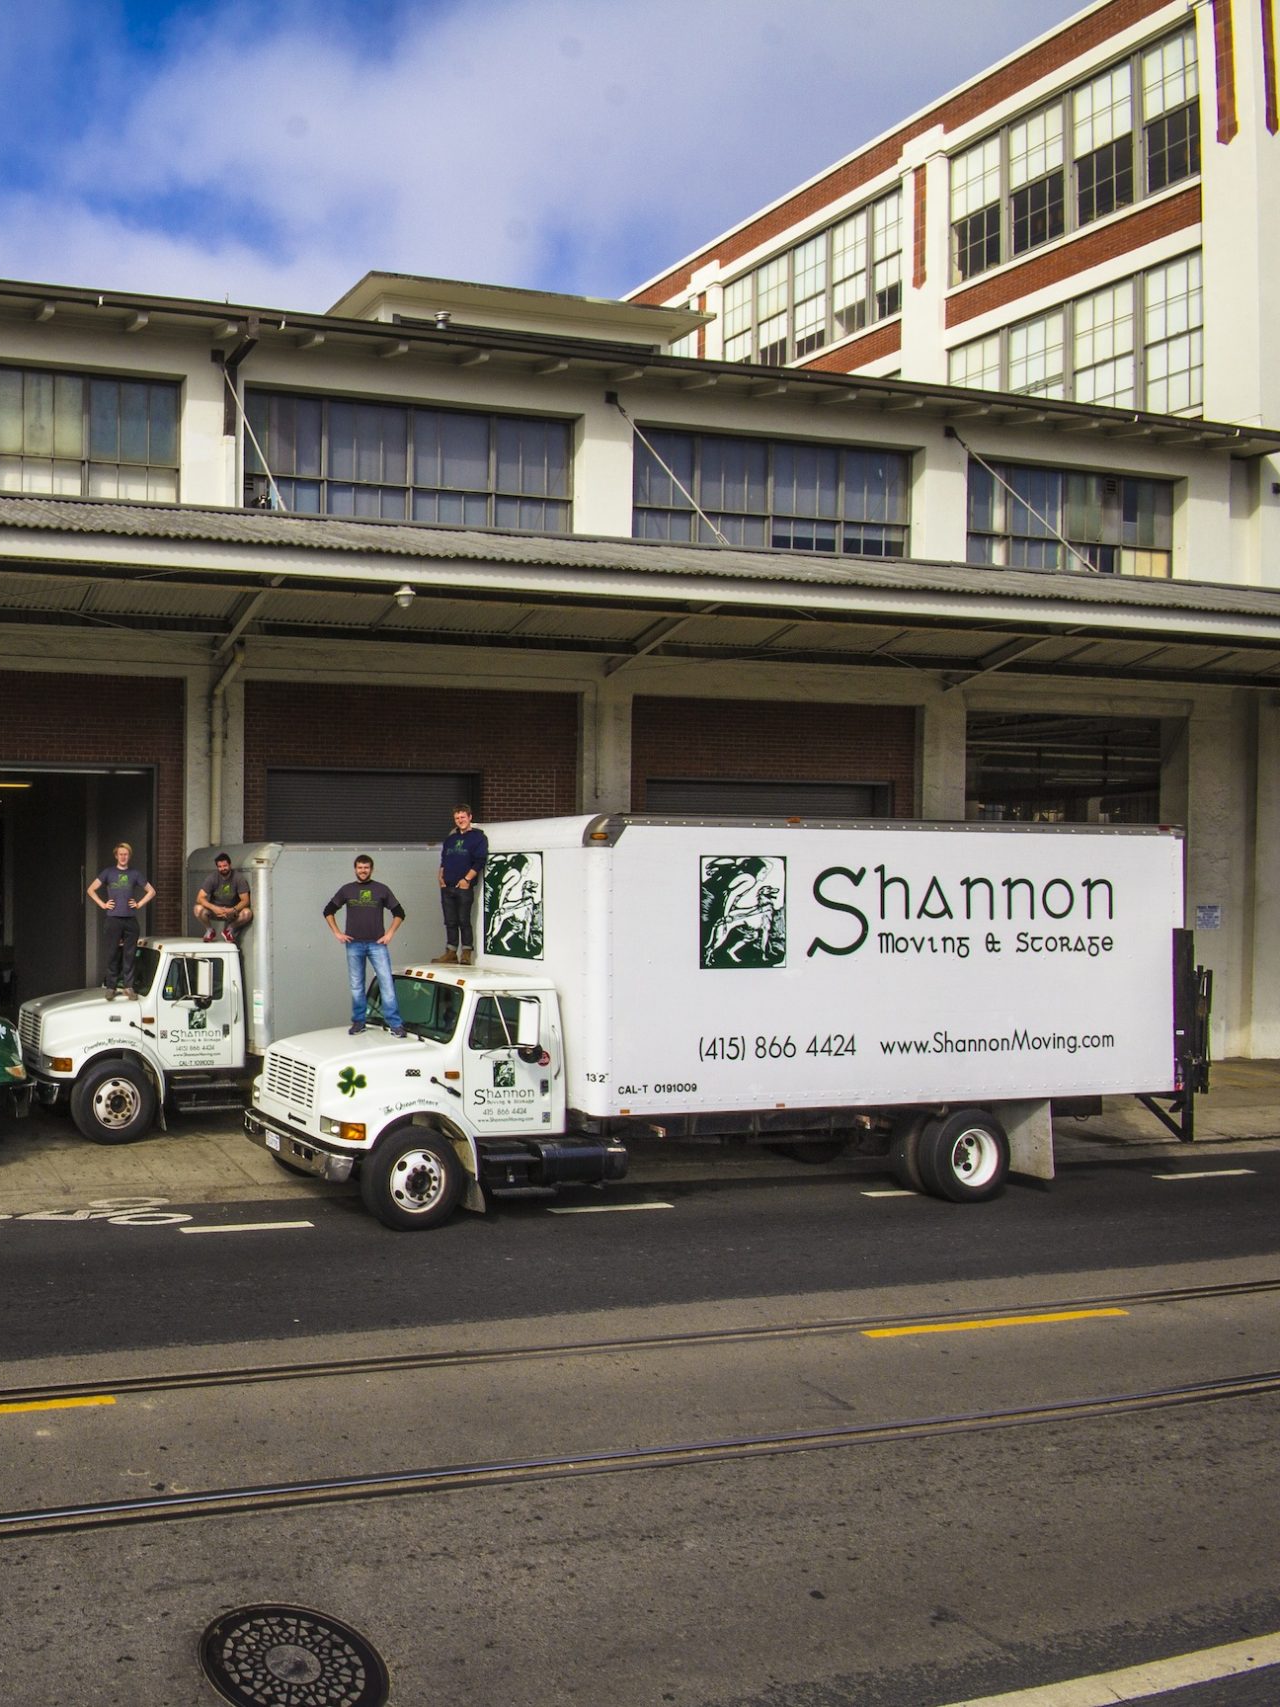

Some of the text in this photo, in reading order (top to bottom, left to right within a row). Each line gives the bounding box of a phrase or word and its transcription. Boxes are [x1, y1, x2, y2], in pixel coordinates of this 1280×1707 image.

[806, 864, 1114, 957] Shannon
[877, 932, 1114, 957] Moving & Storage
[170, 1029, 221, 1043] Shannon
[698, 1034, 857, 1062] (415) 866 4424
[879, 1029, 1115, 1054] www.ShannonMoving.com
[474, 1088, 535, 1105] Shannon
[617, 1082, 698, 1095] CAL-T 0191009
